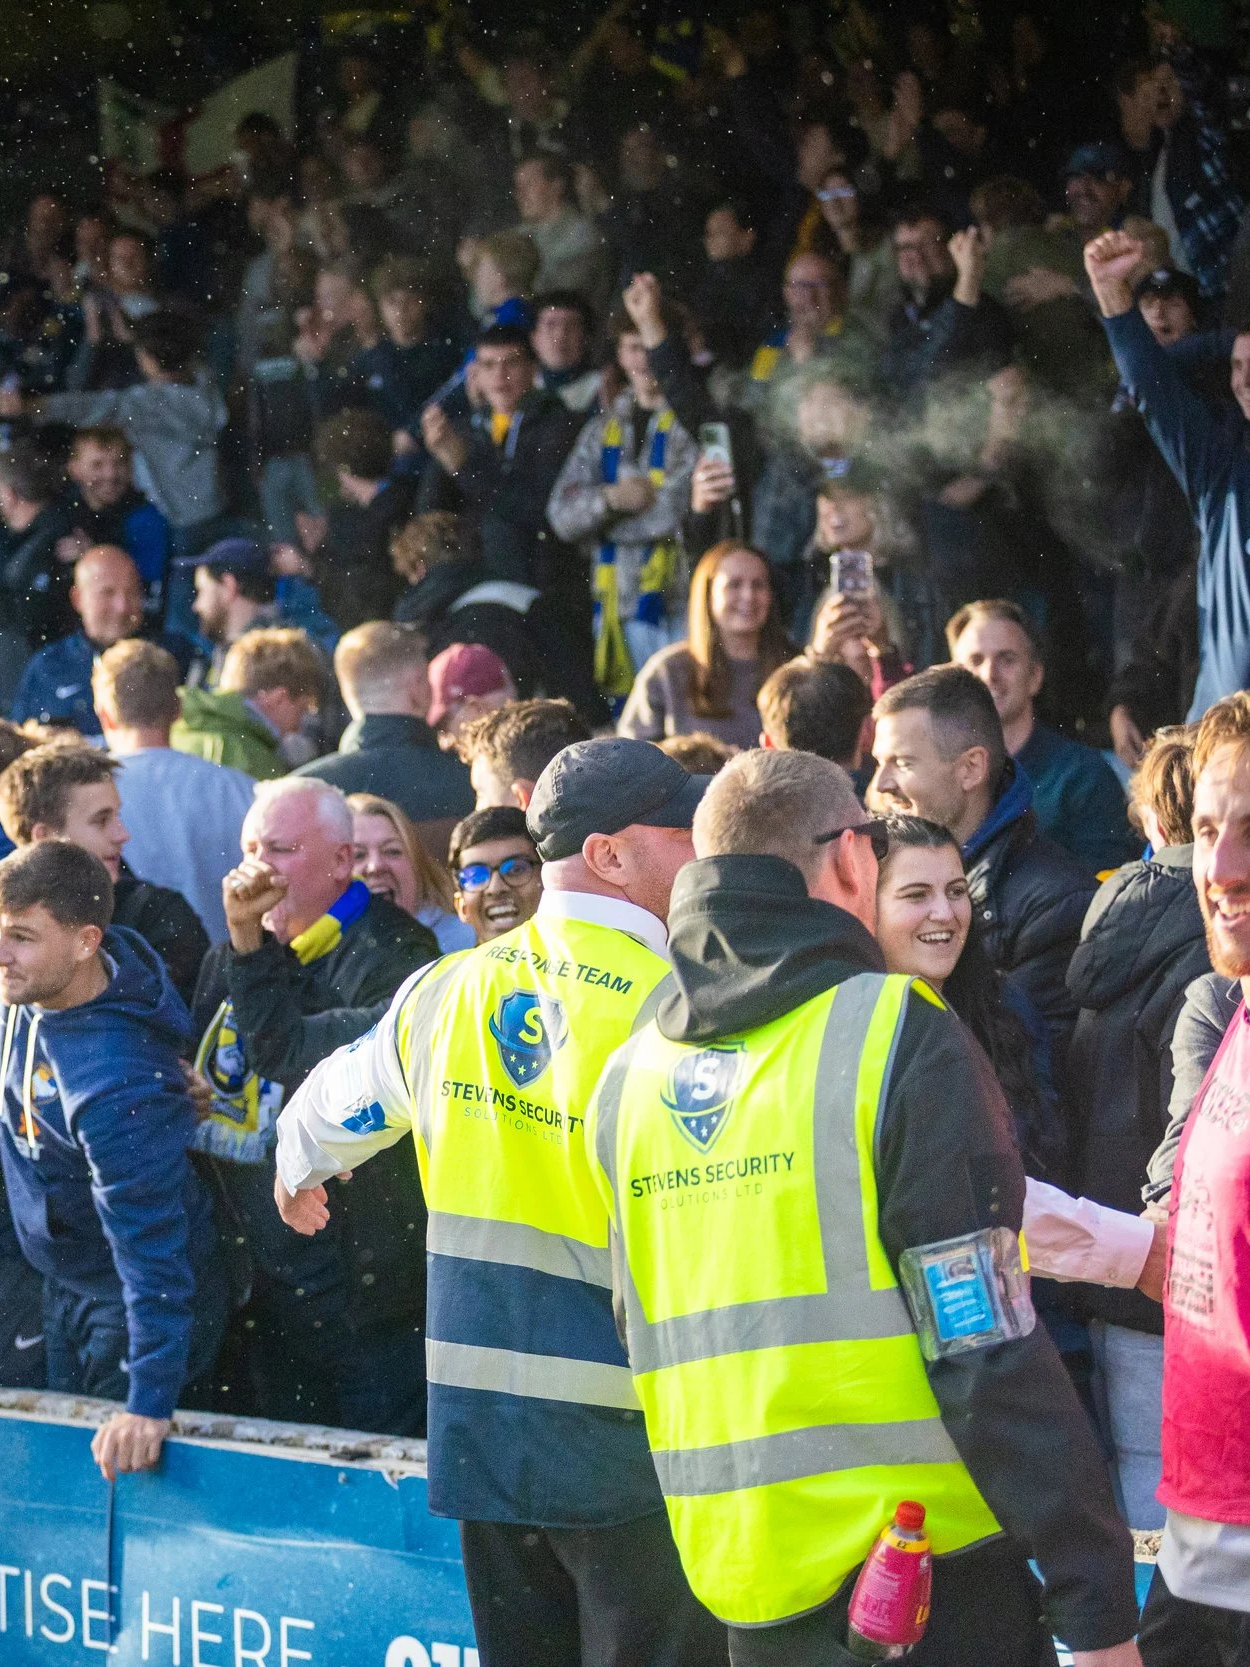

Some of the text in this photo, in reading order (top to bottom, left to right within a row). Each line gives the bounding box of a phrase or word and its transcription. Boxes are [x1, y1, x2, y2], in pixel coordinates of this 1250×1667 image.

[576, 963, 633, 995] TEAM
[690, 1057, 721, 1101] S
[441, 1080, 516, 1112] STEVENS
[464, 1106, 538, 1136] SOLUTIONS
[630, 1151, 795, 1198] STEVENS SECURITY
[661, 1182, 763, 1211] OLUTIONS LTD
[141, 1590, 315, 1667] HERE
